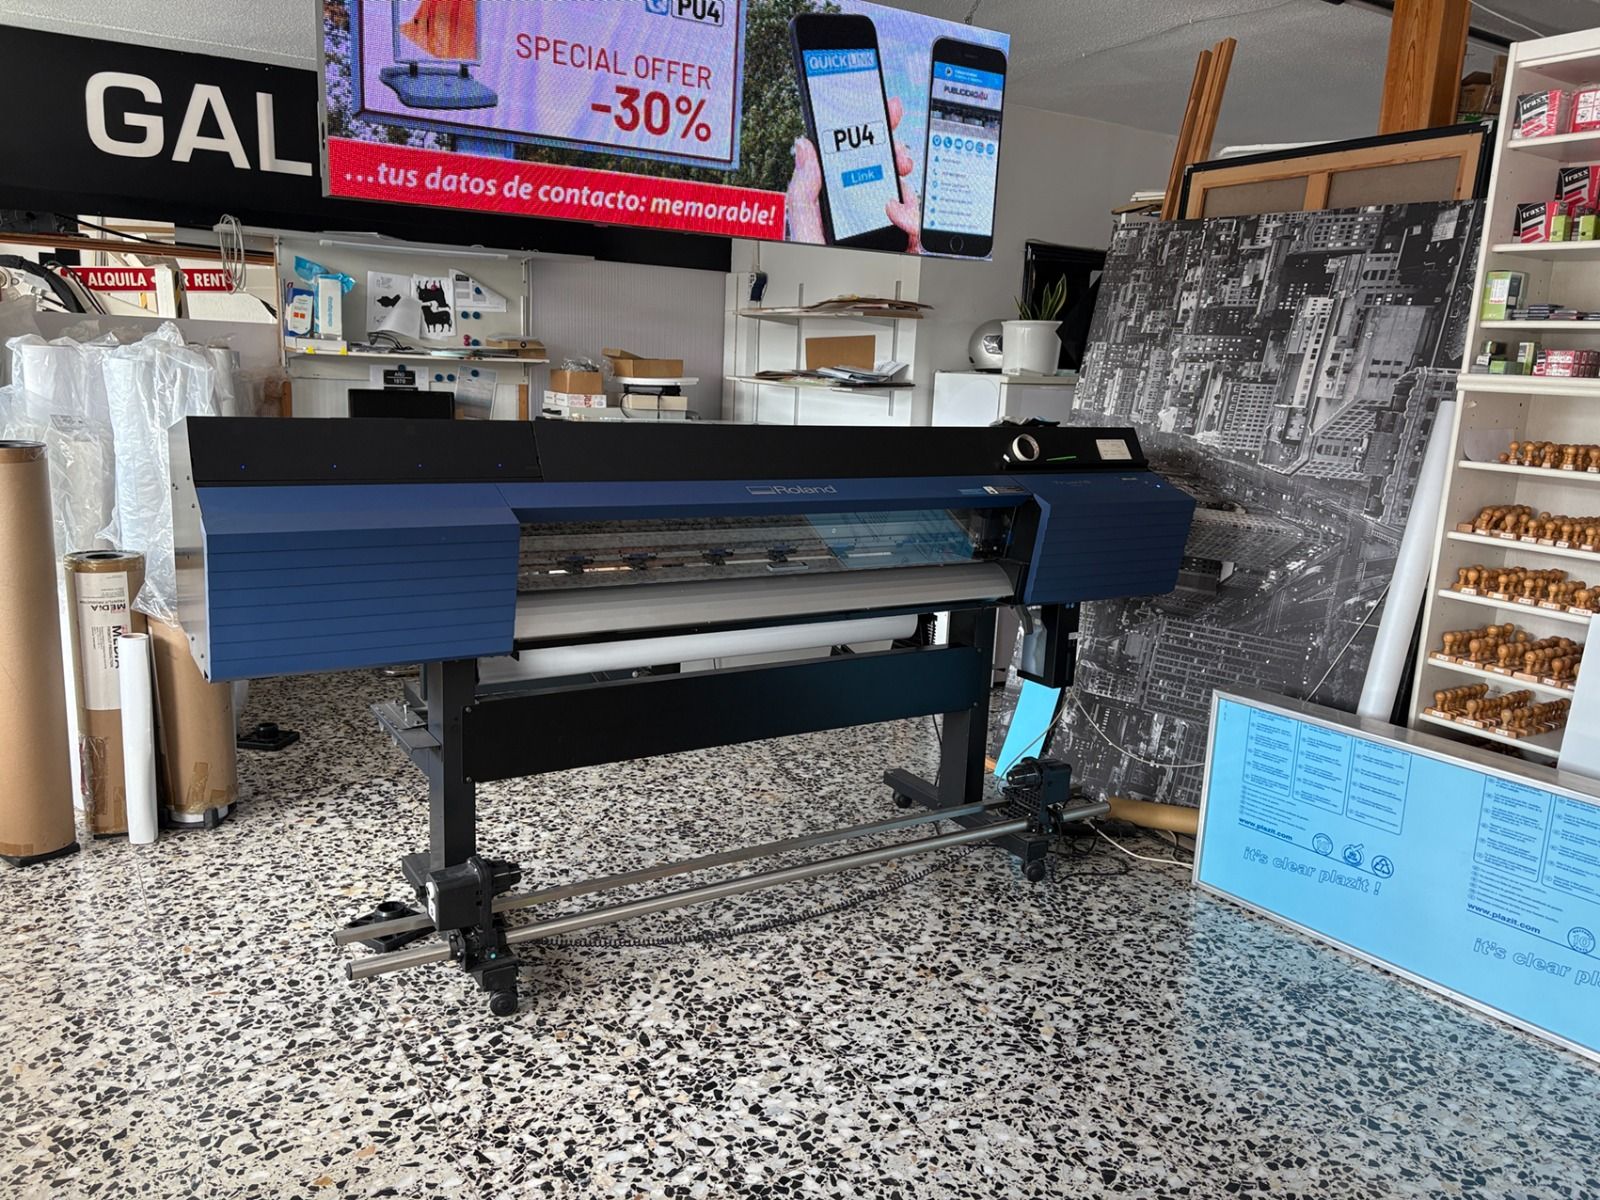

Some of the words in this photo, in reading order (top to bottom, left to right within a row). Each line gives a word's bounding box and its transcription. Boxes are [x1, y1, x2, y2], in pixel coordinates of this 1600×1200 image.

[678, 0, 720, 23] PU4
[516, 33, 627, 76] SPECIAL
[634, 55, 712, 90] OFFER
[85, 71, 312, 177] GAL
[591, 85, 712, 142] -30%
[834, 125, 874, 152] PU4
[851, 170, 876, 184] Link
[1565, 169, 1589, 182] traxx
[425, 166, 498, 196] datos
[503, 175, 534, 200] de
[538, 183, 647, 212] contacto:
[650, 197, 776, 226] memorable!
[1522, 205, 1545, 218] traxx
[88, 271, 147, 287] ALQUILA
[193, 272, 226, 287] RENT
[772, 485, 838, 495] Roland
[91, 603, 126, 612] MEDIA
[1238, 817, 1293, 841] www.plazit.com
[1243, 846, 1269, 865] it's
[1272, 855, 1316, 877] clear
[1318, 869, 1370, 893] plazit
[1467, 902, 1541, 935] www.plazit.com
[1473, 937, 1507, 960] it's
[1512, 951, 1572, 978] clear
[1574, 969, 1600, 987] pl
